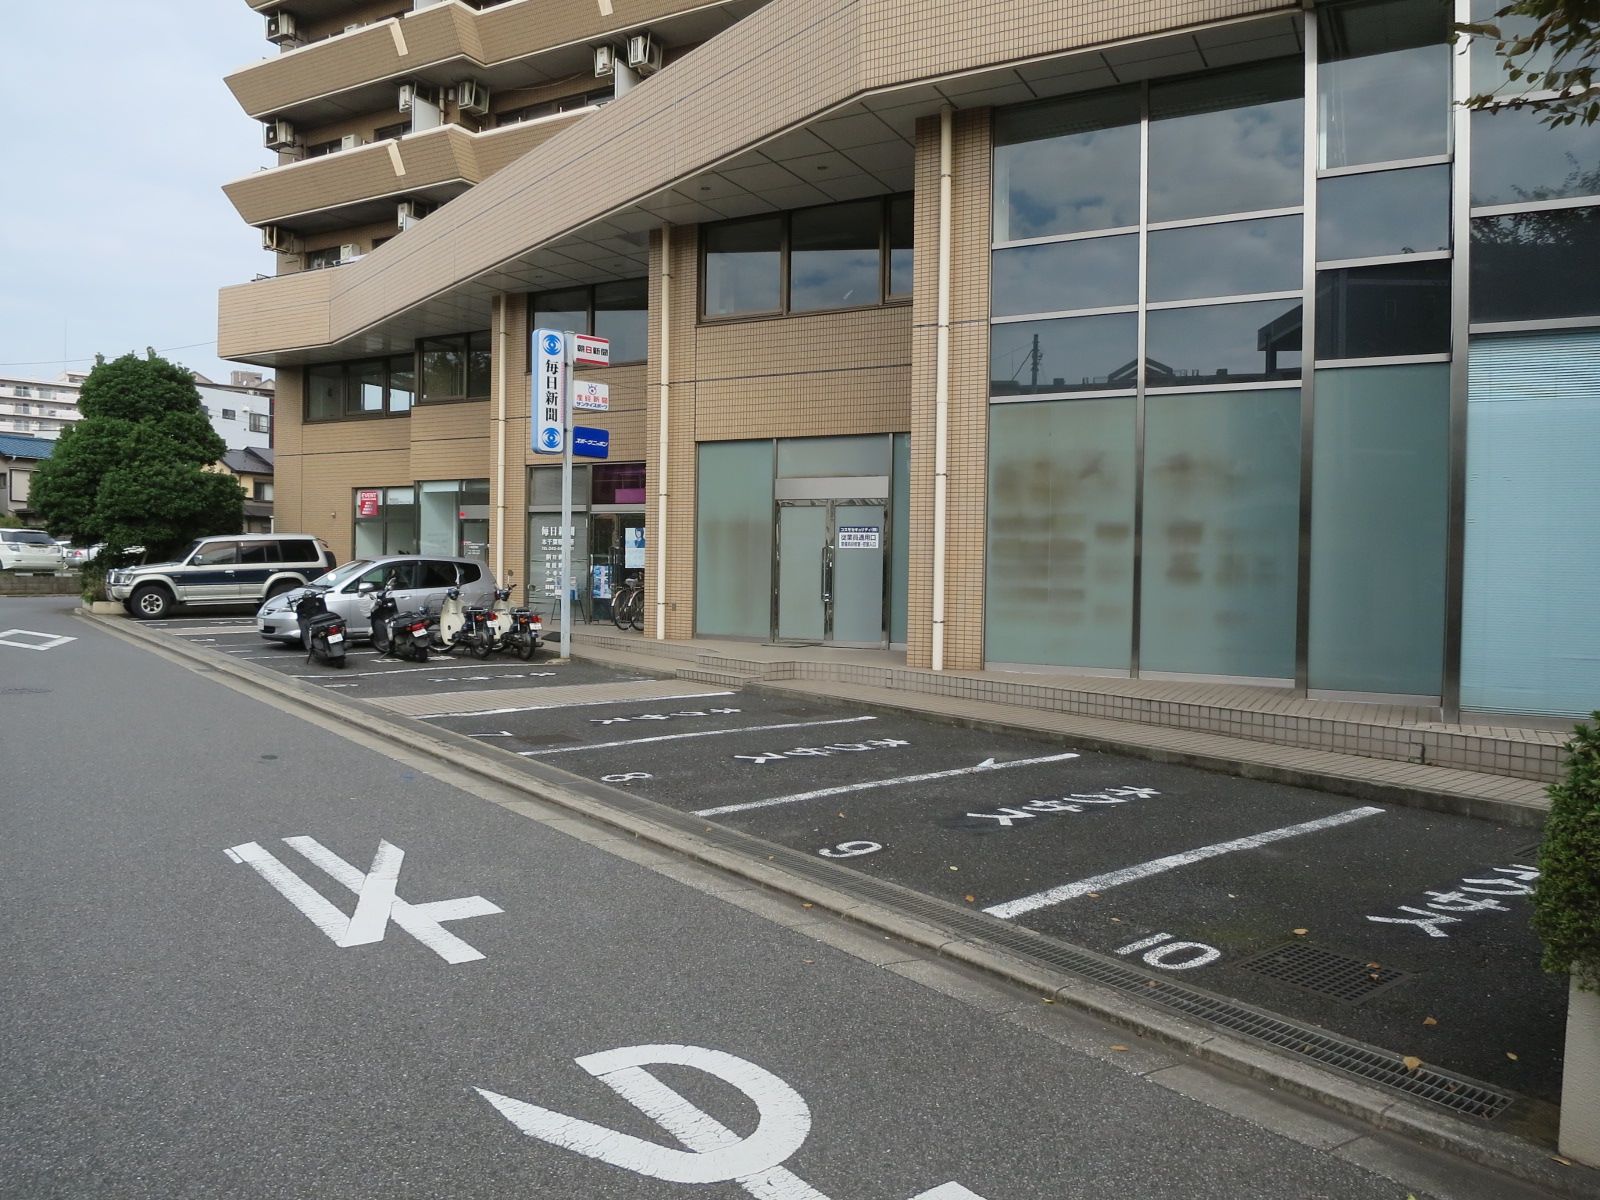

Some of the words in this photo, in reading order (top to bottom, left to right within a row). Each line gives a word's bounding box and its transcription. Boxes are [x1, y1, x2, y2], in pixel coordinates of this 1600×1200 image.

[577, 344, 608, 357] 朝日新聞
[545, 359, 559, 422] 毎日新聞
[733, 738, 911, 764] ネクサス
[600, 771, 653, 782] 8
[966, 785, 1162, 826] ネクサス
[818, 840, 883, 858] 9
[1115, 931, 1221, 970] 10
